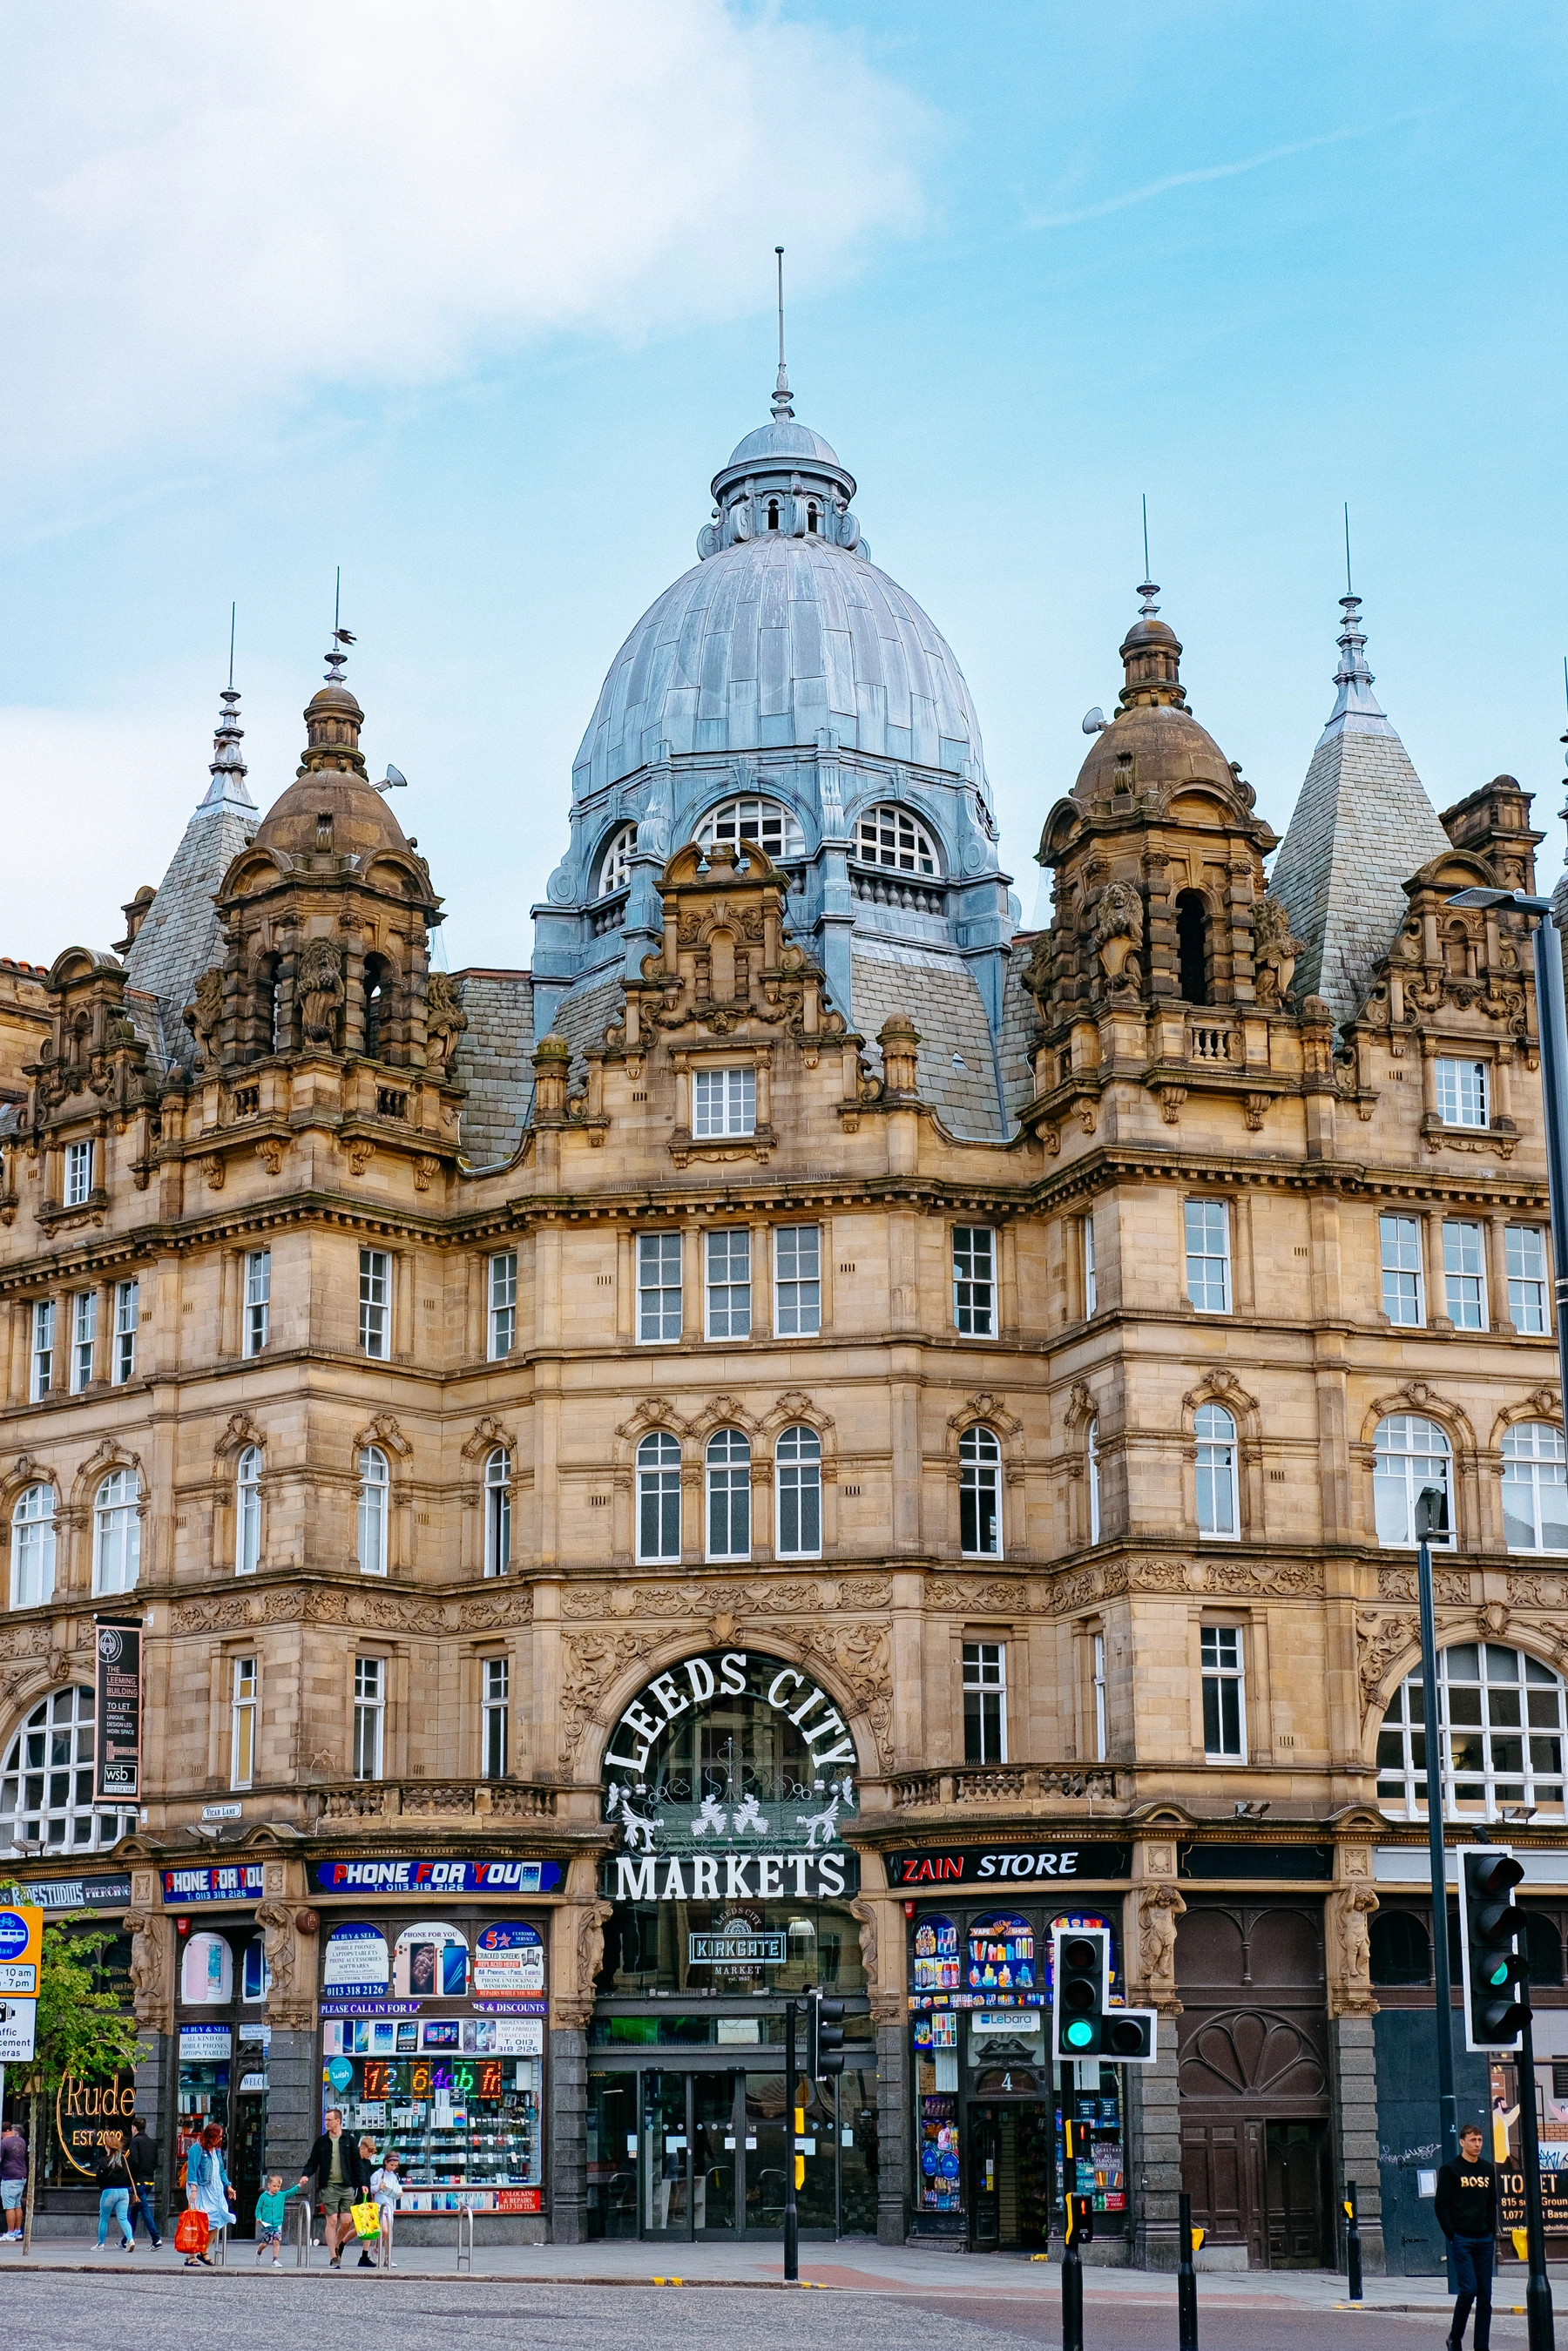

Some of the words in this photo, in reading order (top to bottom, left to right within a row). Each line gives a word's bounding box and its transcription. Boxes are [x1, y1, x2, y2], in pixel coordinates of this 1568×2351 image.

[106, 1676, 136, 1685] LEEMING
[106, 1686, 138, 1696] BUILDING
[605, 1653, 747, 1773] LEEDS
[767, 1668, 856, 1768] CITY
[106, 1766, 128, 1781] wsb
[334, 1863, 410, 1883] PHONE
[416, 1863, 466, 1882] FOR
[474, 1863, 523, 1883] YOU
[902, 1856, 964, 1881] ZAIN
[977, 1852, 1078, 1877] STORE
[166, 1870, 209, 1893] PHONE
[212, 1868, 238, 1889] FOR
[239, 1867, 264, 1888] YOU
[615, 1854, 846, 1901] MARKETS
[85, 1885, 132, 1899] PIERCING
[213, 1890, 226, 1899] 318
[228, 1889, 247, 1898] 2126
[714, 1907, 744, 1926] LEEDS
[745, 1908, 762, 1925] CITY
[485, 1930, 497, 1949] 5
[696, 1939, 780, 1957] KIRKGATE
[714, 1966, 762, 1975] MARKET
[327, 1987, 344, 1996] 0113
[346, 1986, 361, 1996] 318
[362, 1985, 383, 1995] 2126
[321, 2004, 348, 2014] PLEASE
[350, 2004, 374, 2013] CALL
[375, 2003, 385, 2013] IN
[387, 2003, 406, 2012] FOR
[497, 2003, 545, 2012] DISCOUNTS
[991, 2014, 1031, 2023] Lebara
[244, 2077, 265, 2086] WELC
[332, 2071, 349, 2079] wish
[1001, 2073, 1013, 2091] 4
[65, 2073, 136, 2117] Rude
[72, 2130, 94, 2146] EST
[1461, 2177, 1490, 2188] BOSS
[1501, 2174, 1524, 2193] TO
[1540, 2174, 1558, 2193] ET
[1501, 2198, 1517, 2206] 815
[1503, 2211, 1524, 2220] 1,077
